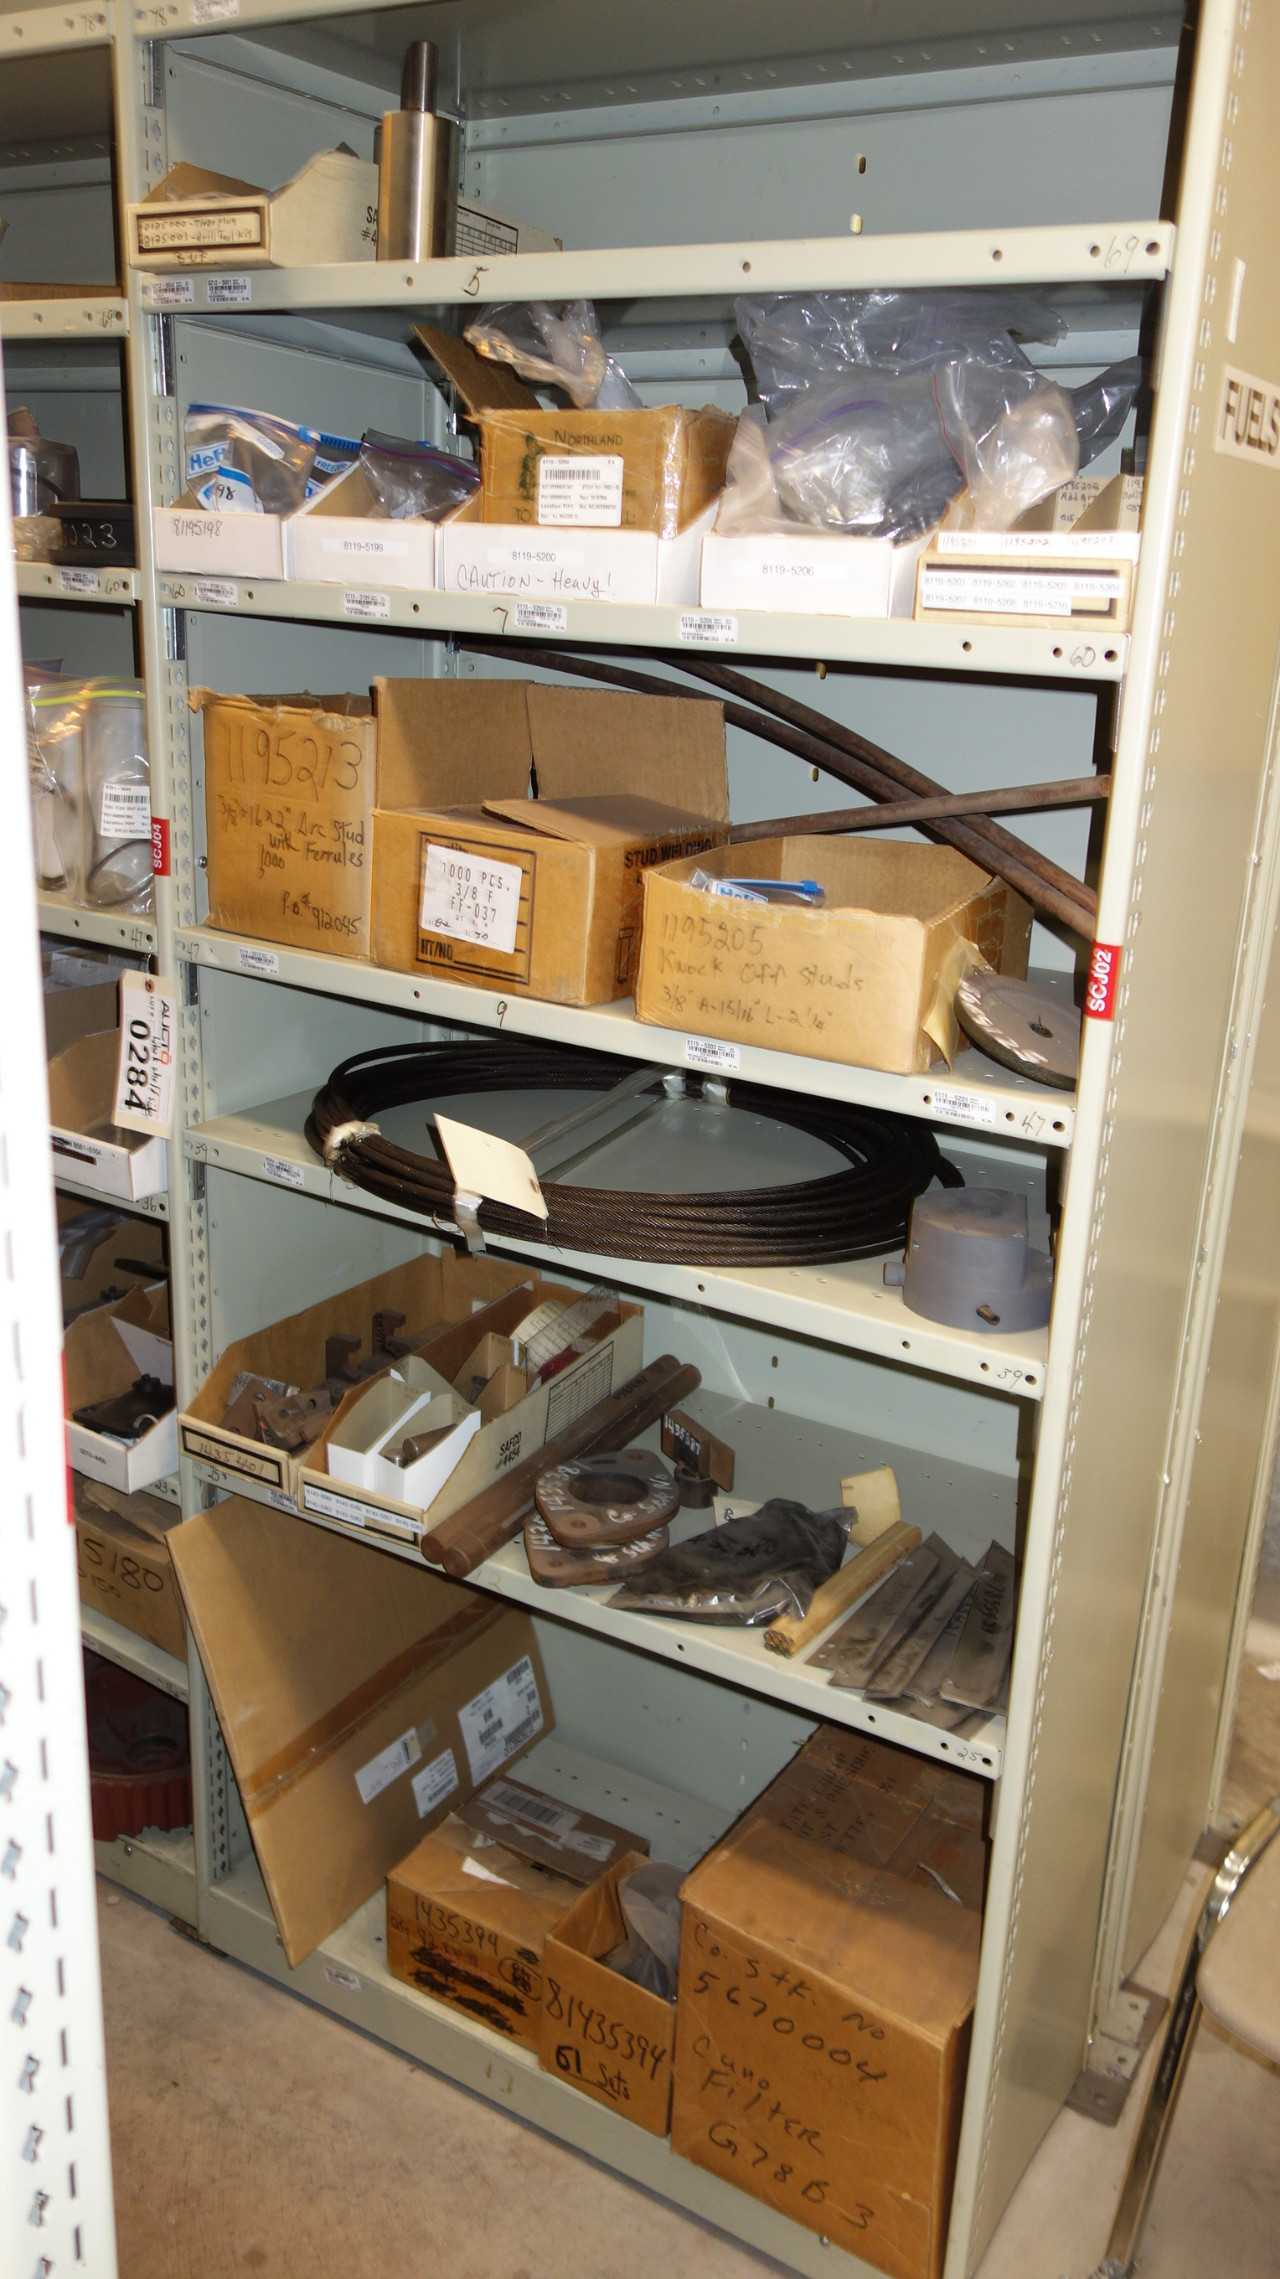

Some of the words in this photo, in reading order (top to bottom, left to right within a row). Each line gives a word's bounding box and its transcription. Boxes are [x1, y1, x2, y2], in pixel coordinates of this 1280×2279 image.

[1223, 378, 1280, 456] FUELS
[512, 551, 557, 562] 8119-5200
[457, 564, 532, 591] CAUTION
[1070, 646, 1096, 667] 60
[222, 725, 362, 801] 1195213
[152, 824, 162, 869] SCJ04
[625, 848, 657, 869] STUD
[441, 861, 472, 883] 1000
[456, 882, 478, 901] 3/8
[663, 912, 767, 956] 1195205
[1090, 949, 1112, 1012] SCJ02
[496, 1000, 508, 1029] 9
[124, 1019, 151, 1113] 0284
[415, 1895, 499, 1956] 1435394
[546, 1977, 667, 2080] 81435394
[555, 2045, 582, 2075] 61
